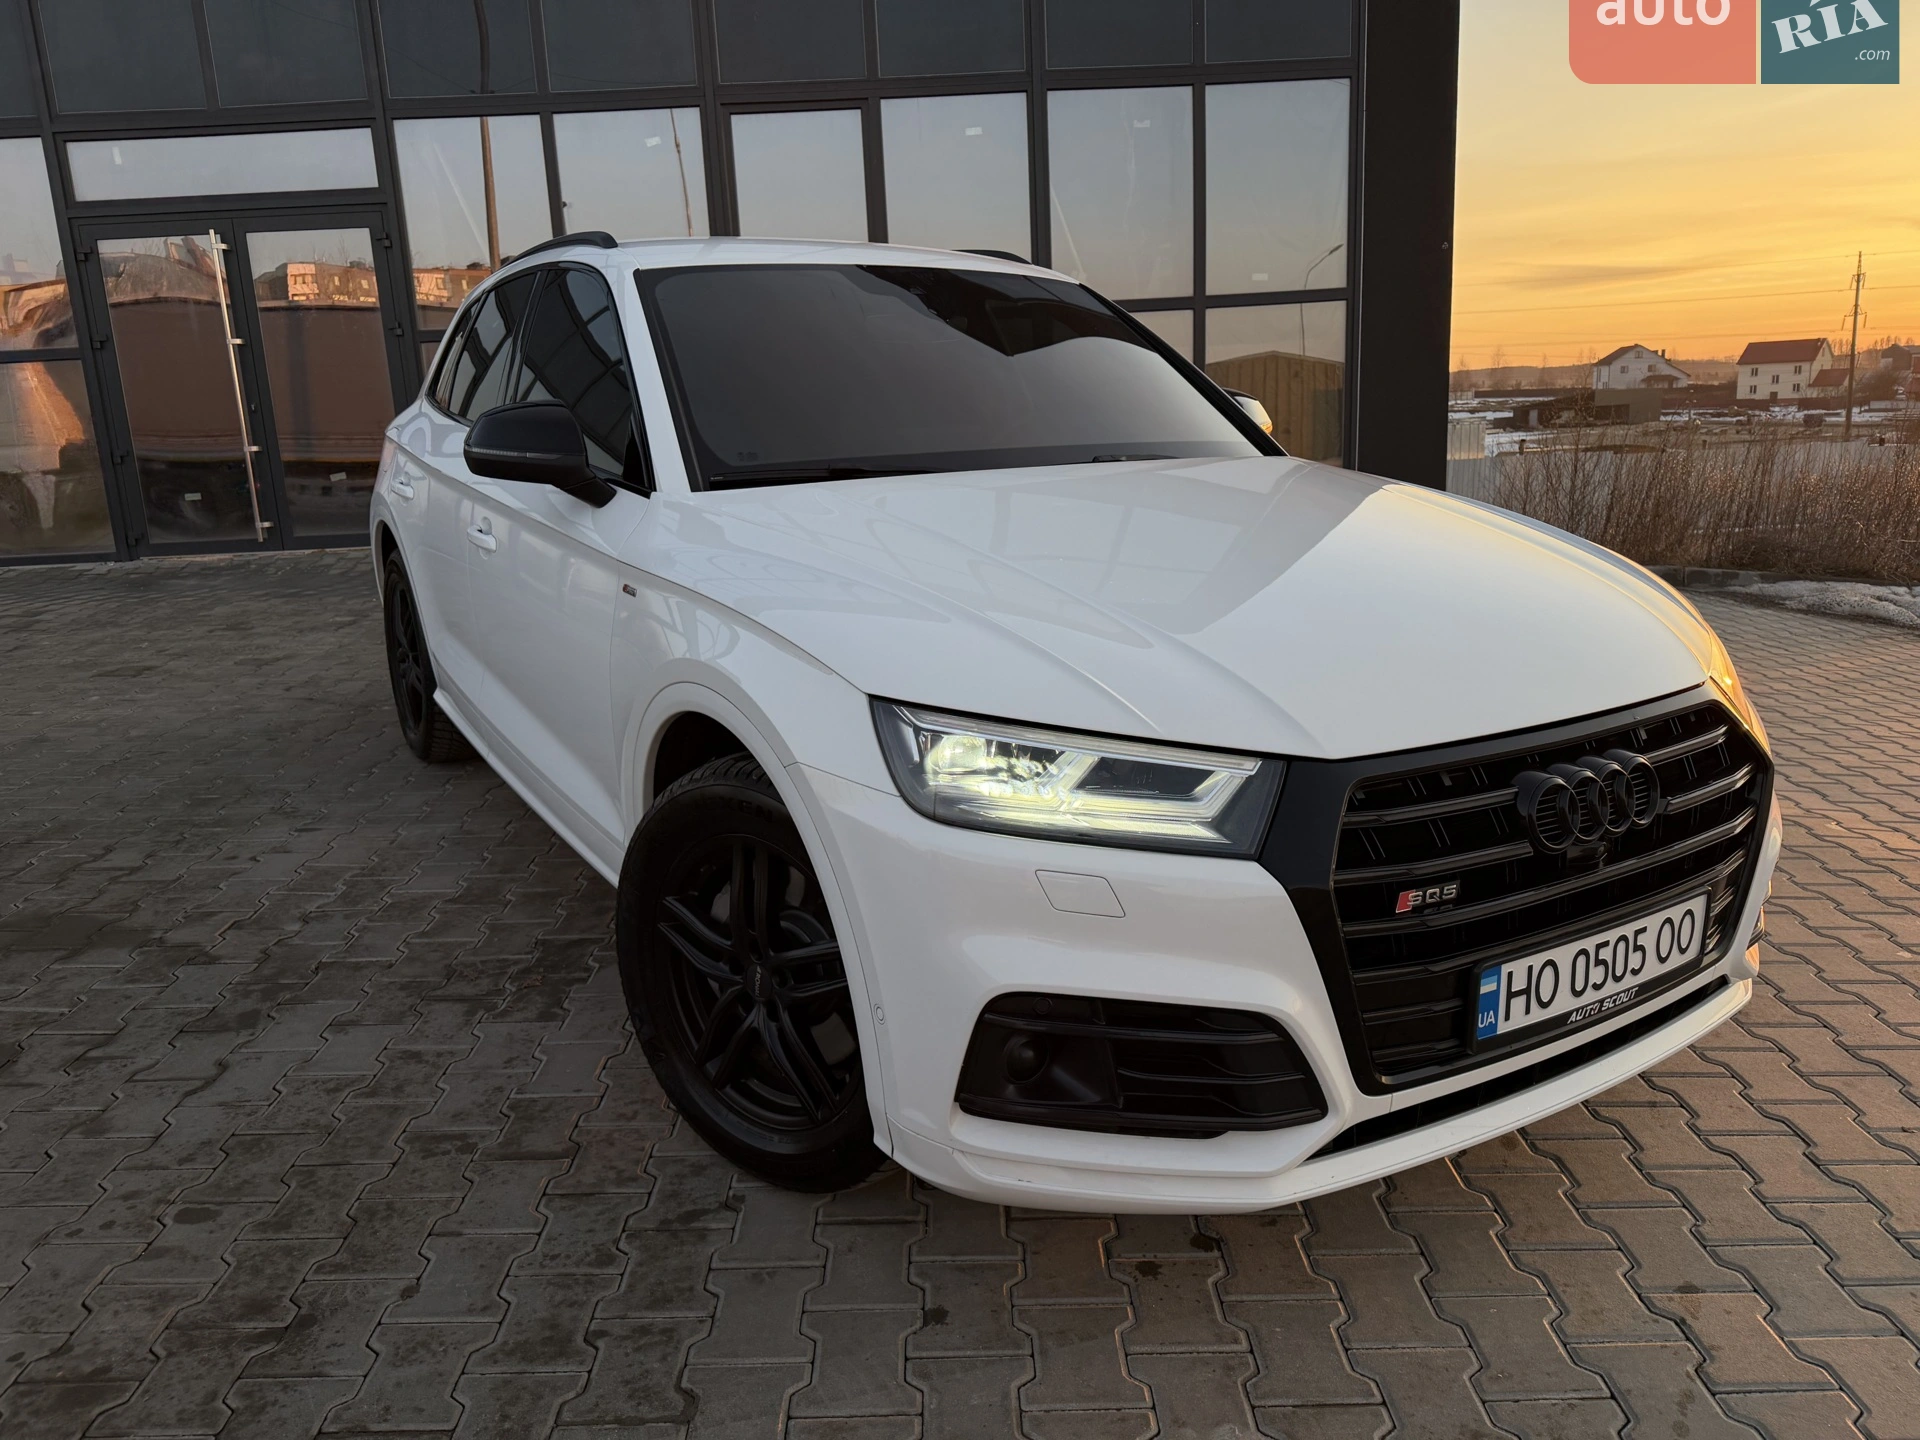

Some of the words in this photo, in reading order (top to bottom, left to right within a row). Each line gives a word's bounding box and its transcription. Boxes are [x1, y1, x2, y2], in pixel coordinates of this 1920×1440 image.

[1407, 884, 1457, 907] SQ5
[1504, 958, 1560, 1022] HO
[1570, 926, 1648, 998] 0505
[1656, 908, 1696, 964] OO
[1478, 1009, 1496, 1028] UA
[1566, 1002, 1601, 1025] AUTO
[1601, 986, 1639, 1011] SCOUT
